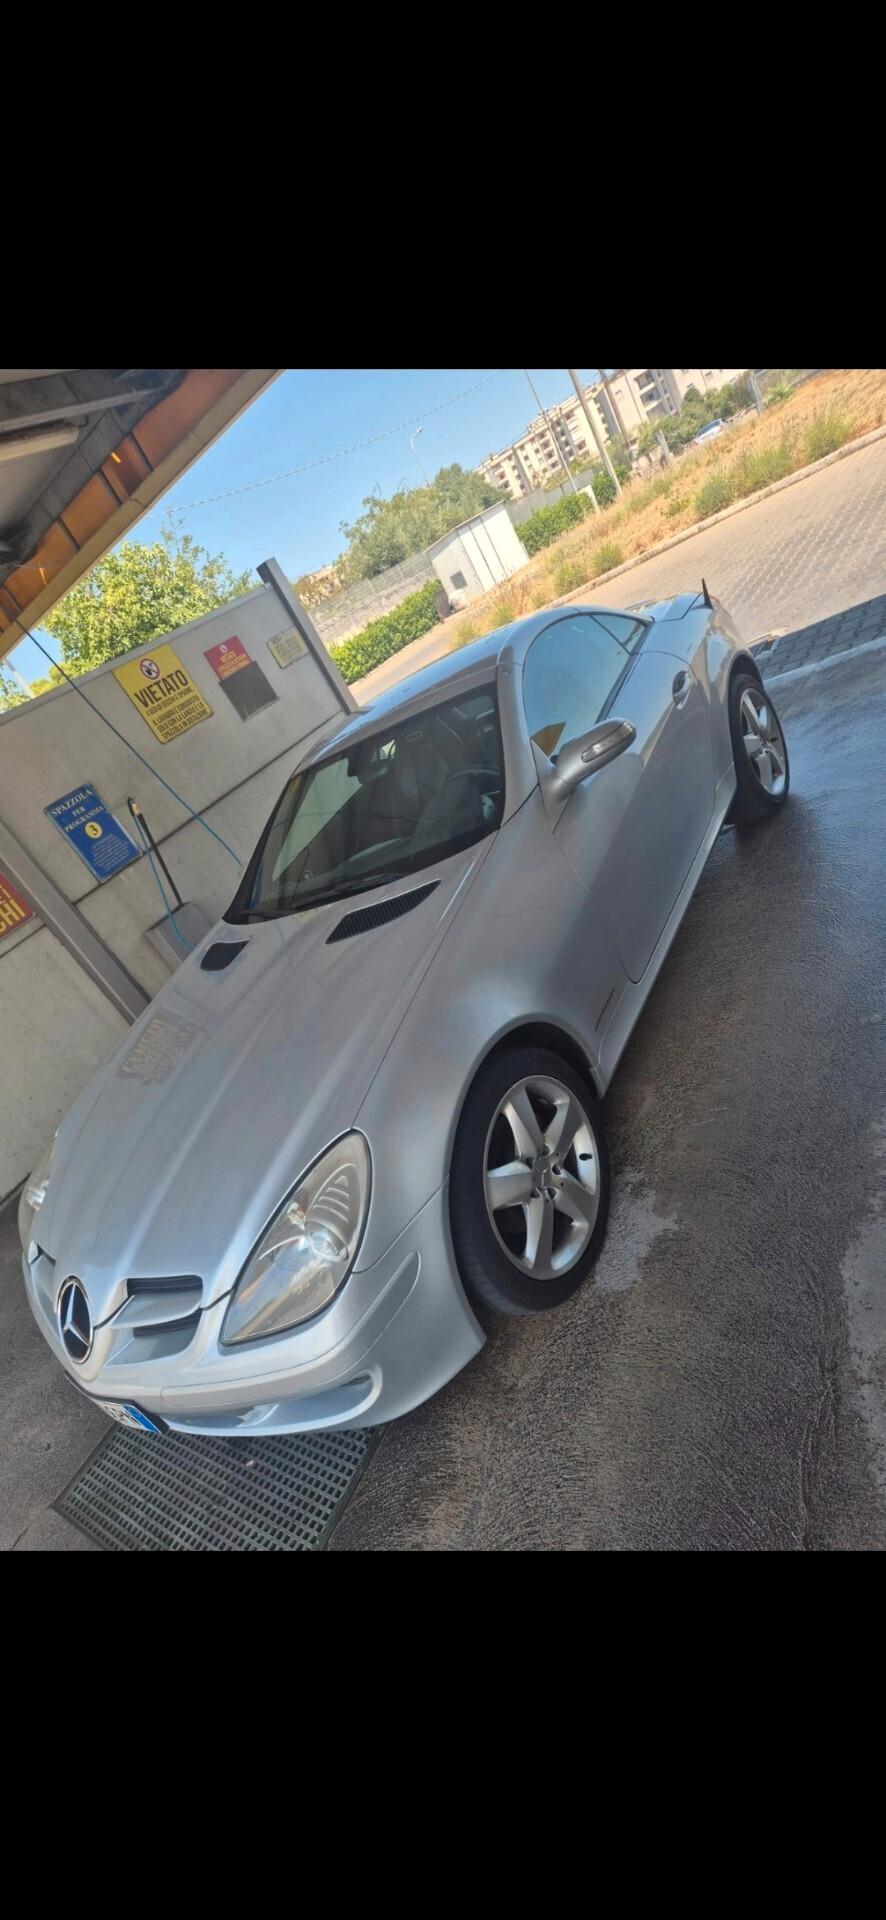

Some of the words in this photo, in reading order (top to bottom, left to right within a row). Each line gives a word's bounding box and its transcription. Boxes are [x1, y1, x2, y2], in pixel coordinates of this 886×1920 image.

[134, 670, 188, 708] VIETATO
[51, 789, 93, 816] SPAZZOLA
[72, 806, 87, 817] PER
[64, 806, 104, 833] PROGRAMMA
[88, 824, 98, 836] 3
